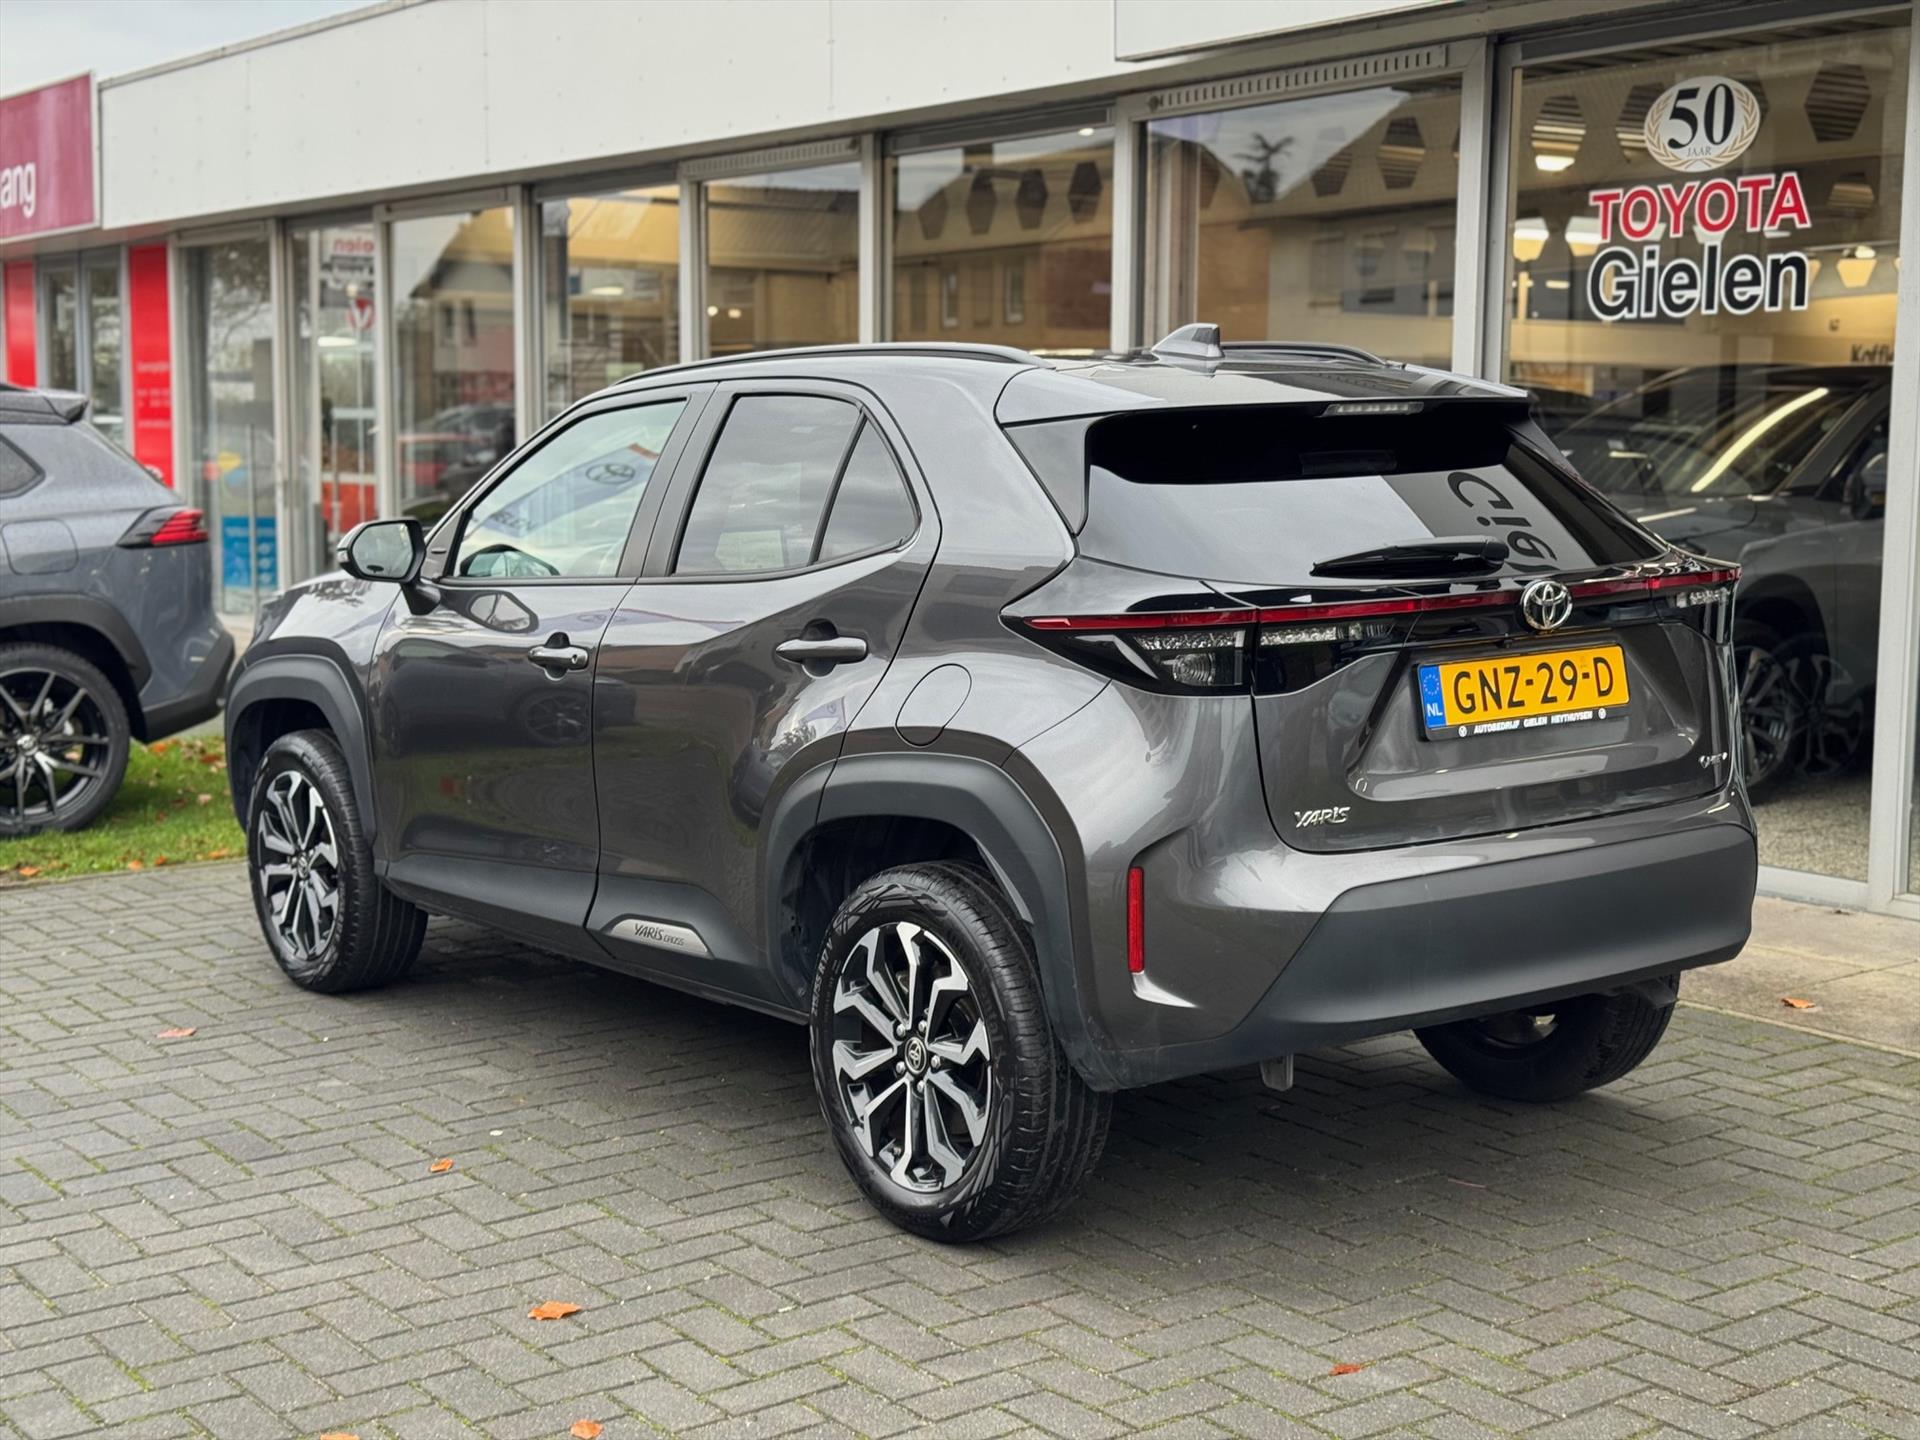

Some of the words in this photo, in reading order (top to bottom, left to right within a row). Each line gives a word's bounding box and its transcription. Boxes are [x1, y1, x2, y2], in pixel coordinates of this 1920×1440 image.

[1667, 83, 1735, 149] 50
[1686, 146, 1712, 158] JAAR
[0, 162, 36, 218] ang
[1589, 172, 1812, 243] TOYOTA
[1587, 241, 1809, 321] Gielen
[1453, 656, 1614, 715] GNZ-29-D
[1426, 702, 1443, 718] NL
[1473, 719, 1520, 734] AUTOBEDRIJF
[1523, 716, 1548, 728] GIELEN
[1551, 710, 1593, 724] HEYTHUYSEN
[1294, 806, 1351, 829] YARIS
[634, 922, 665, 941] YARIS
[663, 934, 686, 946] CROSS
